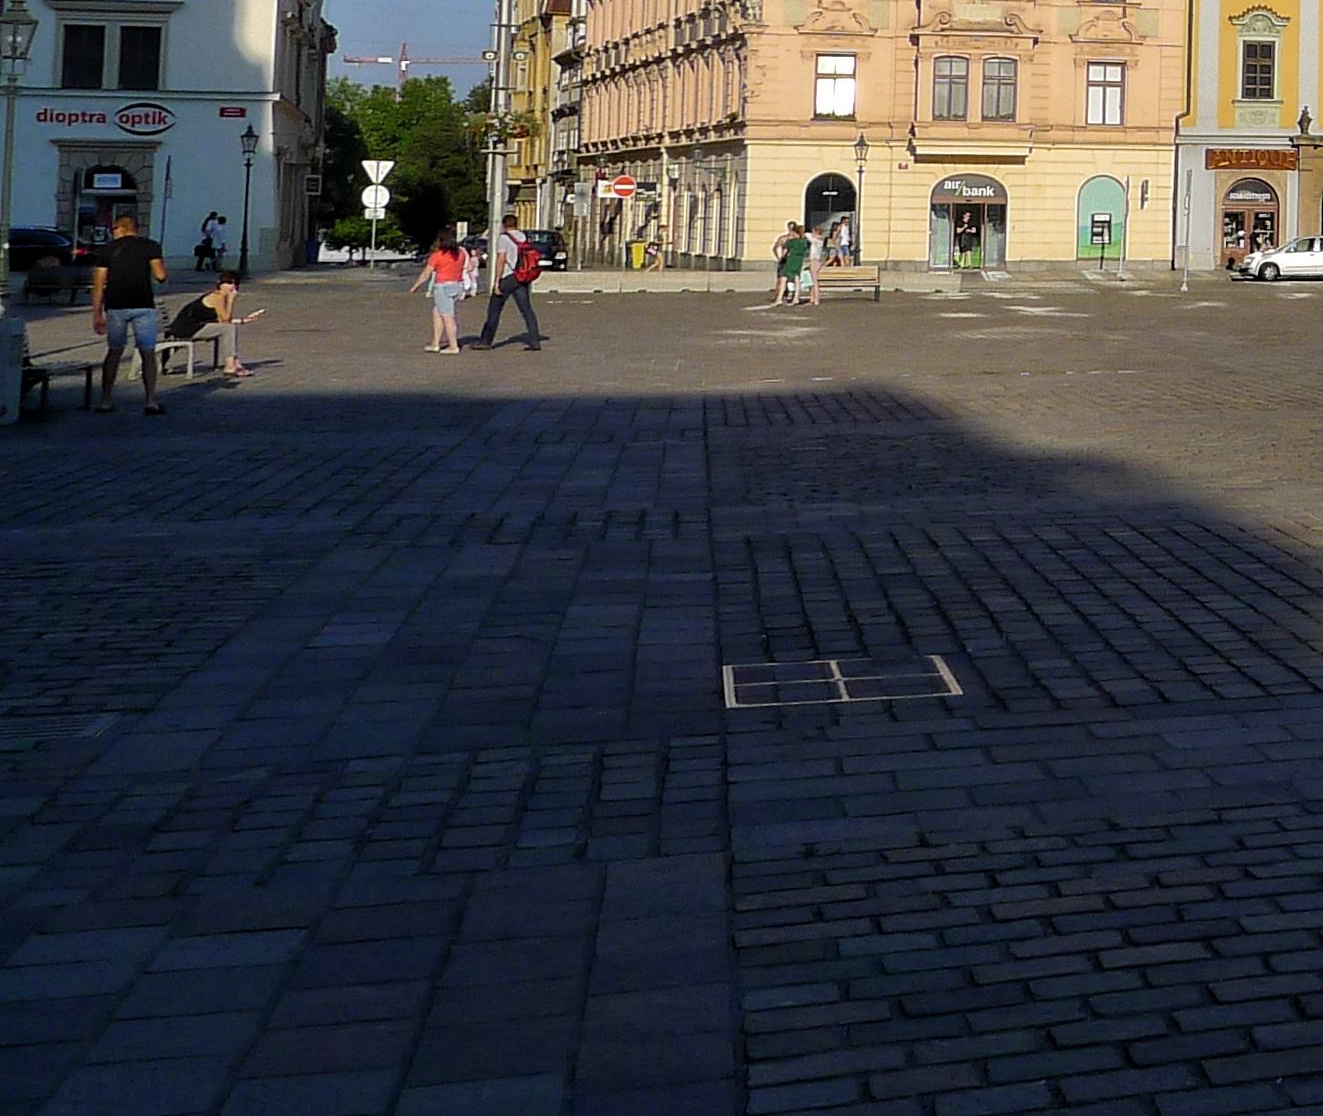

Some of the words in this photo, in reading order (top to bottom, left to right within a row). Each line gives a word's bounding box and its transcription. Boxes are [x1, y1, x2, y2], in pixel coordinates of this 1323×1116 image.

[36, 108, 107, 127] dioptra
[118, 111, 169, 128] optik
[1213, 149, 1297, 166] ANTIQUE
[943, 180, 962, 190] air
[962, 185, 996, 197] bank
